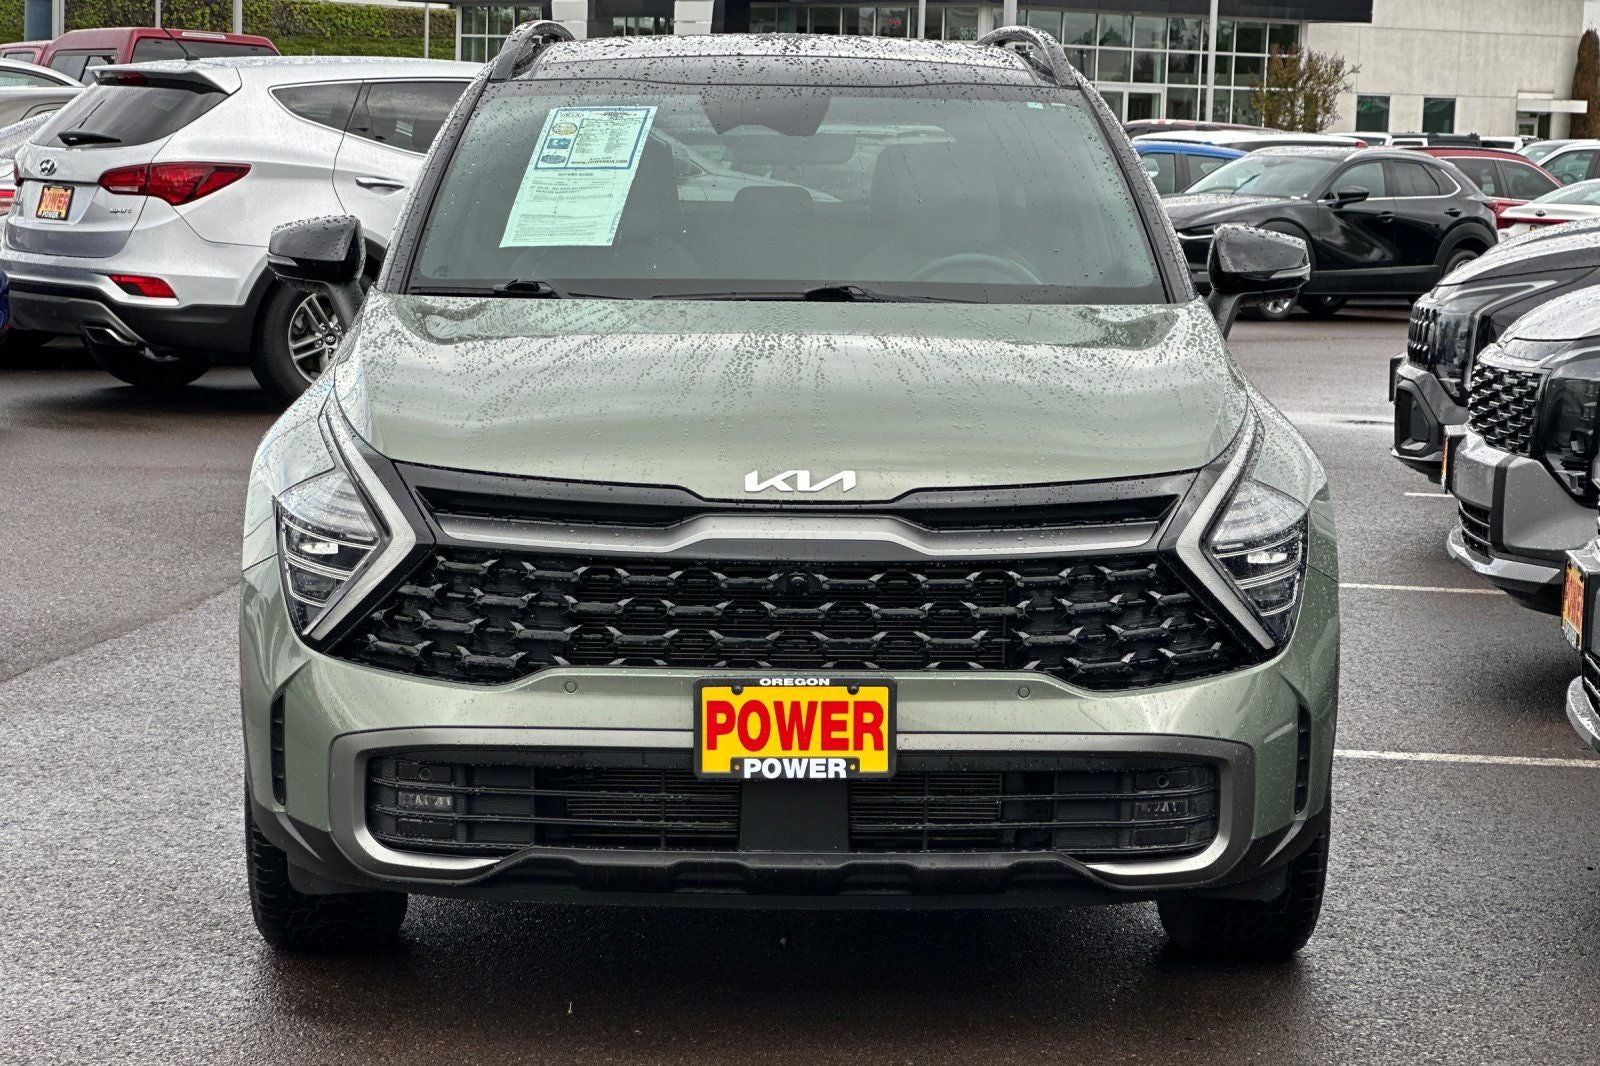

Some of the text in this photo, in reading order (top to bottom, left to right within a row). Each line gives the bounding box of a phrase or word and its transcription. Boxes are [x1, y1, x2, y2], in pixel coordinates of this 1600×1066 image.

[960, 27, 977, 40] 3675
[43, 191, 69, 210] POWER
[745, 470, 856, 493] KIA
[759, 678, 830, 686] OREGON
[706, 700, 884, 752] POWER
[743, 757, 847, 779] POWER
